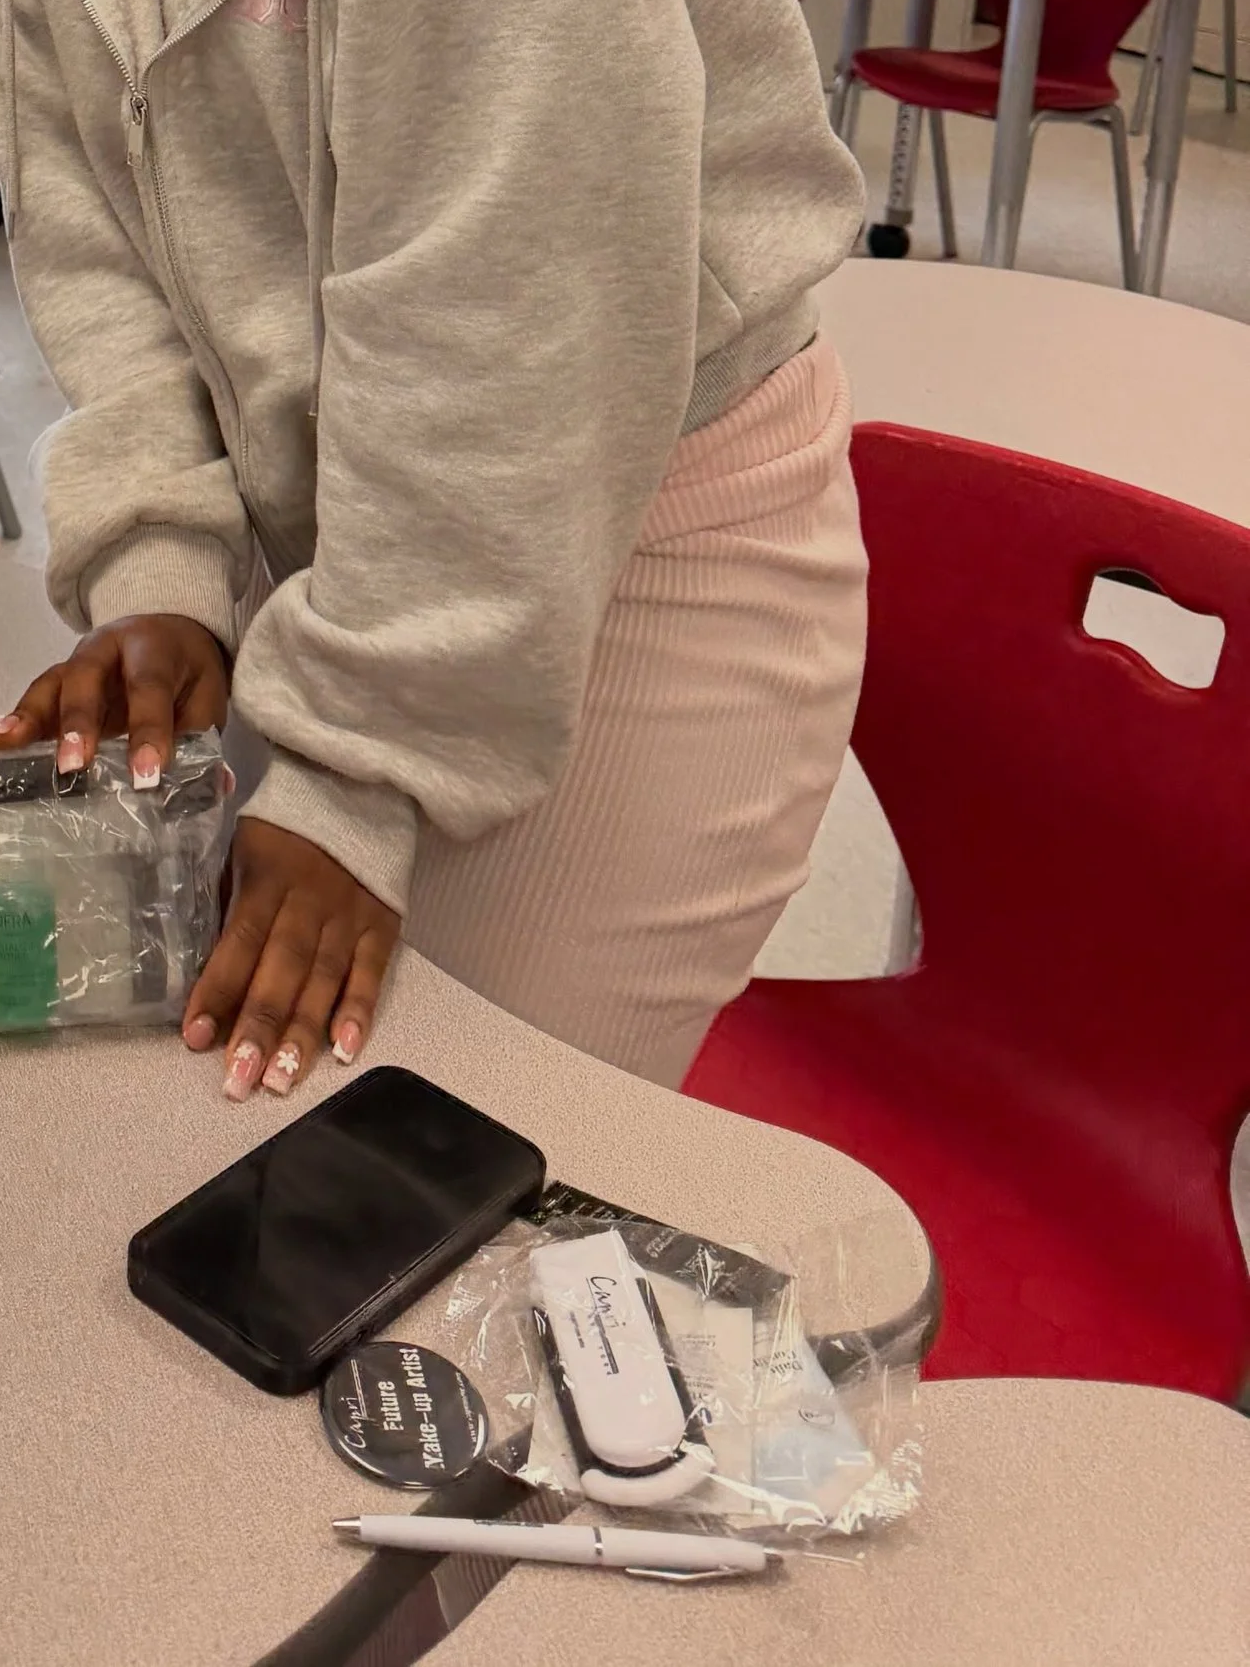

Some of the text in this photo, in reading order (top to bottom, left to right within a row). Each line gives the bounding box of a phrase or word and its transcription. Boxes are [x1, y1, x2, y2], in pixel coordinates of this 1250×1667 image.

[340, 1396, 377, 1449] Capri
[377, 1380, 404, 1431] Future
[398, 1347, 446, 1470] Make-up Artist
